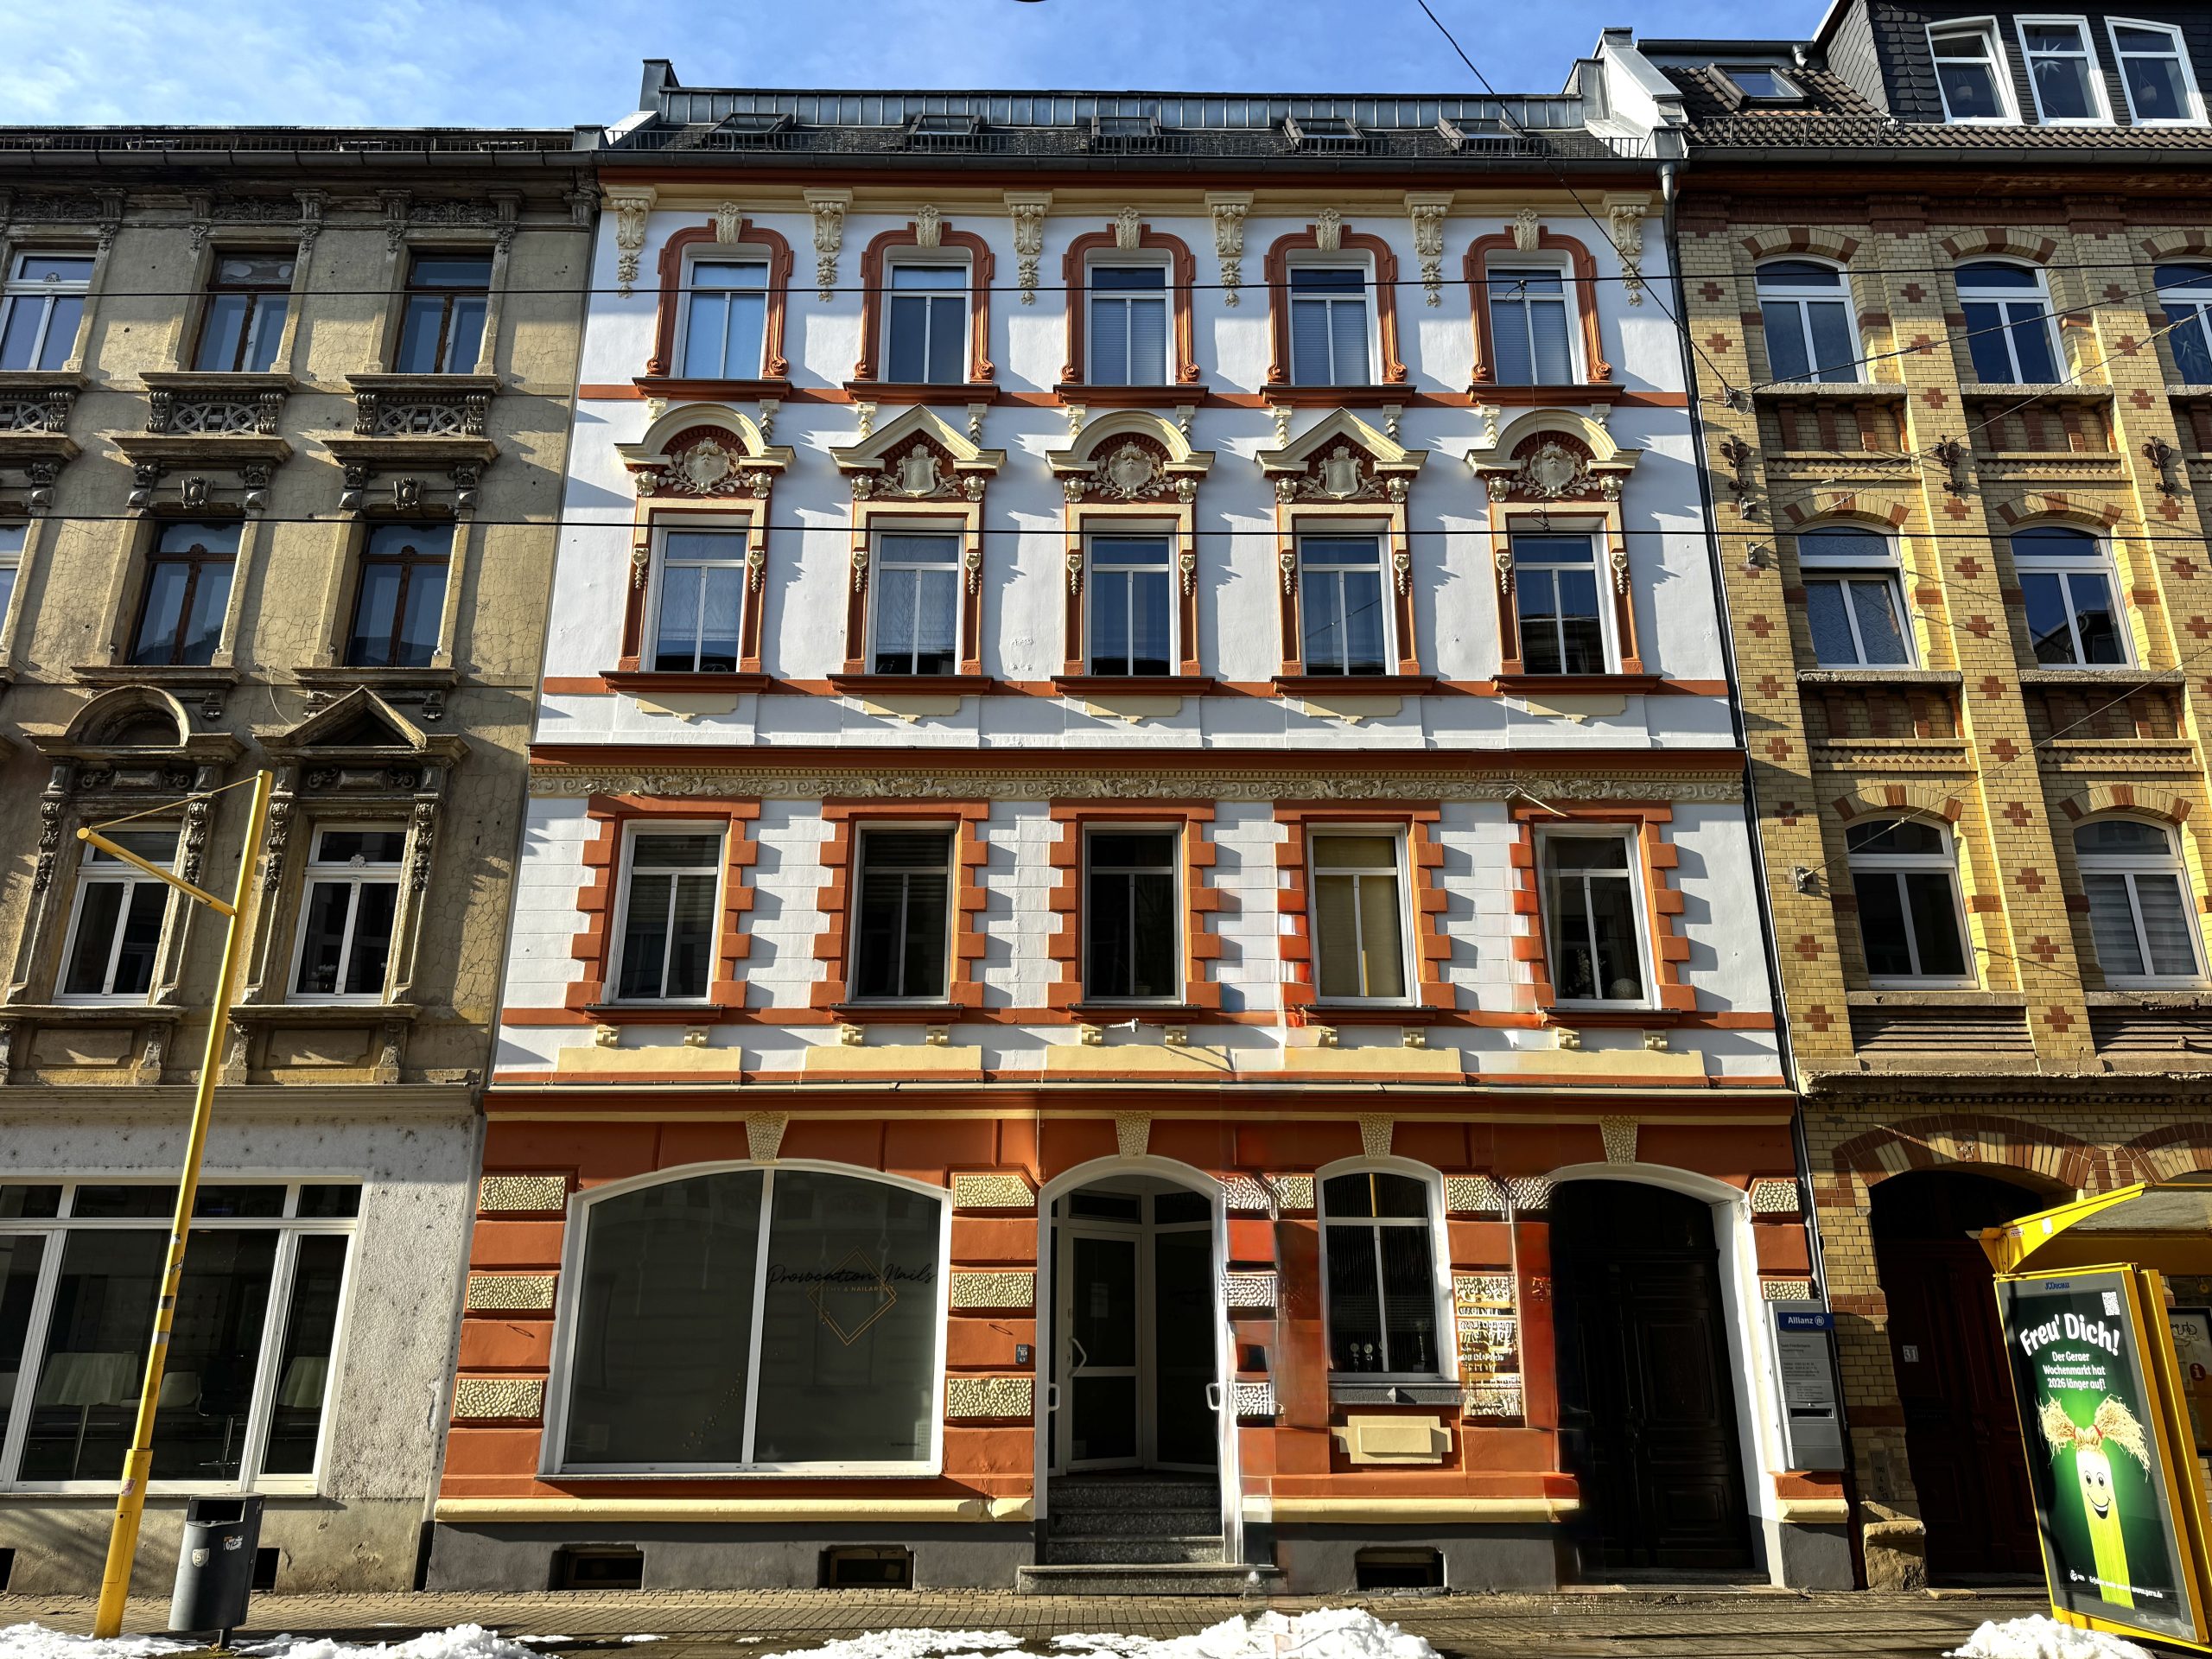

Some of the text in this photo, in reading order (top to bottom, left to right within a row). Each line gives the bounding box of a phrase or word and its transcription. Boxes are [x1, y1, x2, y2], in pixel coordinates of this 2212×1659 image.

[883, 1263, 937, 1284] Nails
[1788, 1316, 1814, 1325] Allianz
[2019, 1313, 2120, 1357] Freu' Dich!
[1904, 1349, 1916, 1359] 31
[2051, 1351, 2090, 1362] Der Geraer
[2042, 1364, 2106, 1376] Wochenmarkt hat
[2047, 1377, 2107, 1392] 2026 länger auf!
